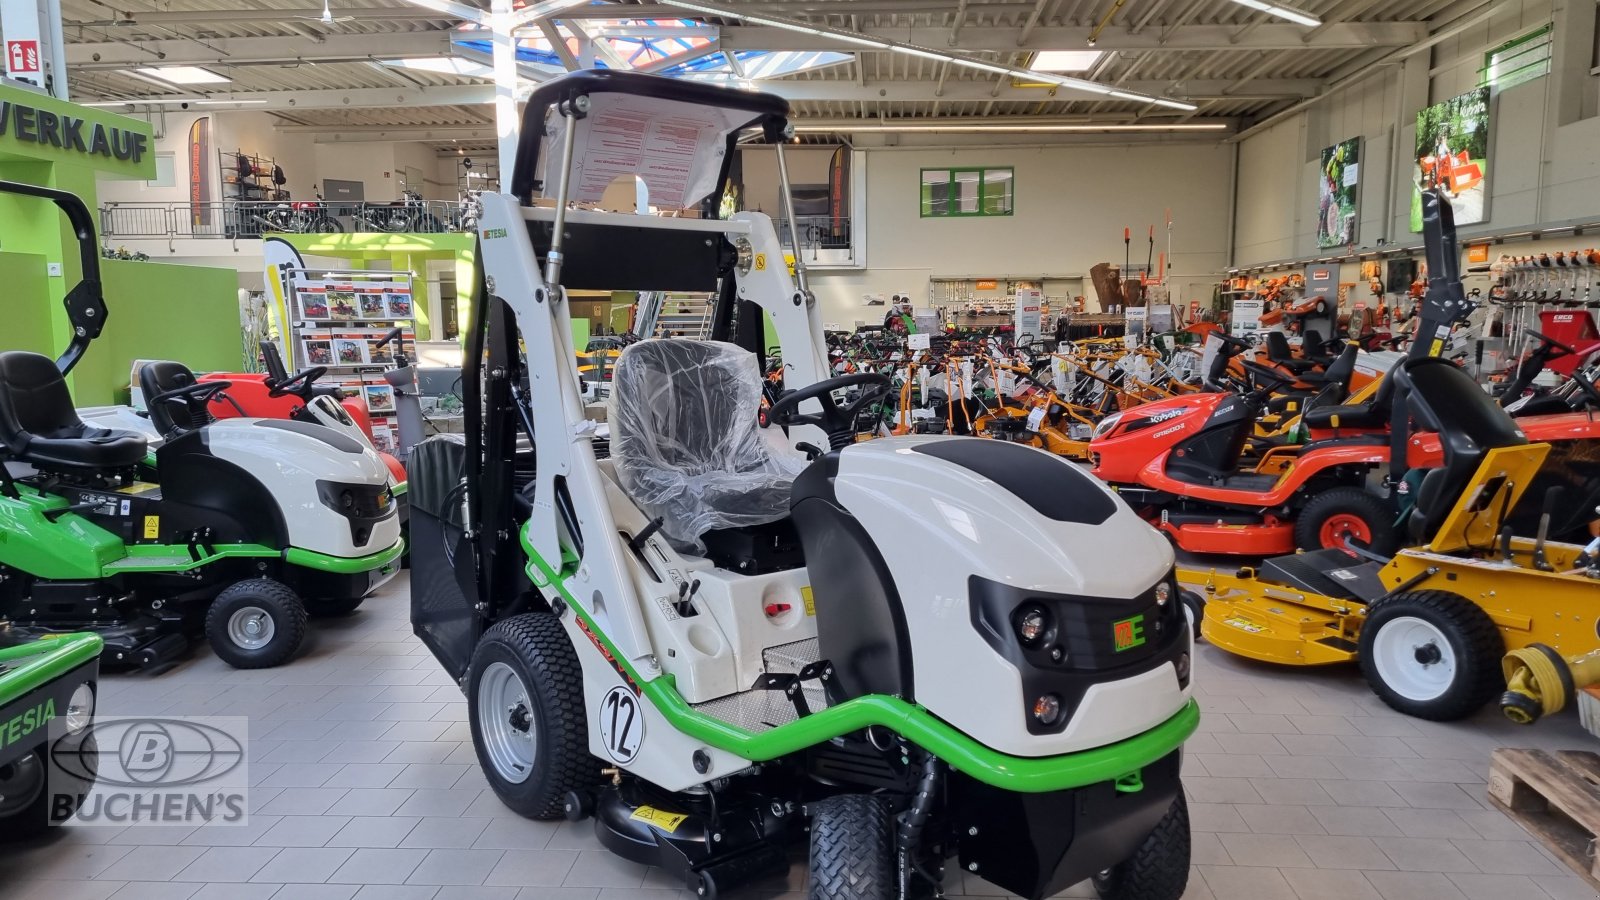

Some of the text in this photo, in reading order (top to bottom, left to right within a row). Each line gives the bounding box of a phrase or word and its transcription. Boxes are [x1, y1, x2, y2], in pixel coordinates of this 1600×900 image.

[483, 228, 508, 240] ETESIA
[1151, 409, 1182, 423] Kubota
[608, 691, 635, 758] 12
